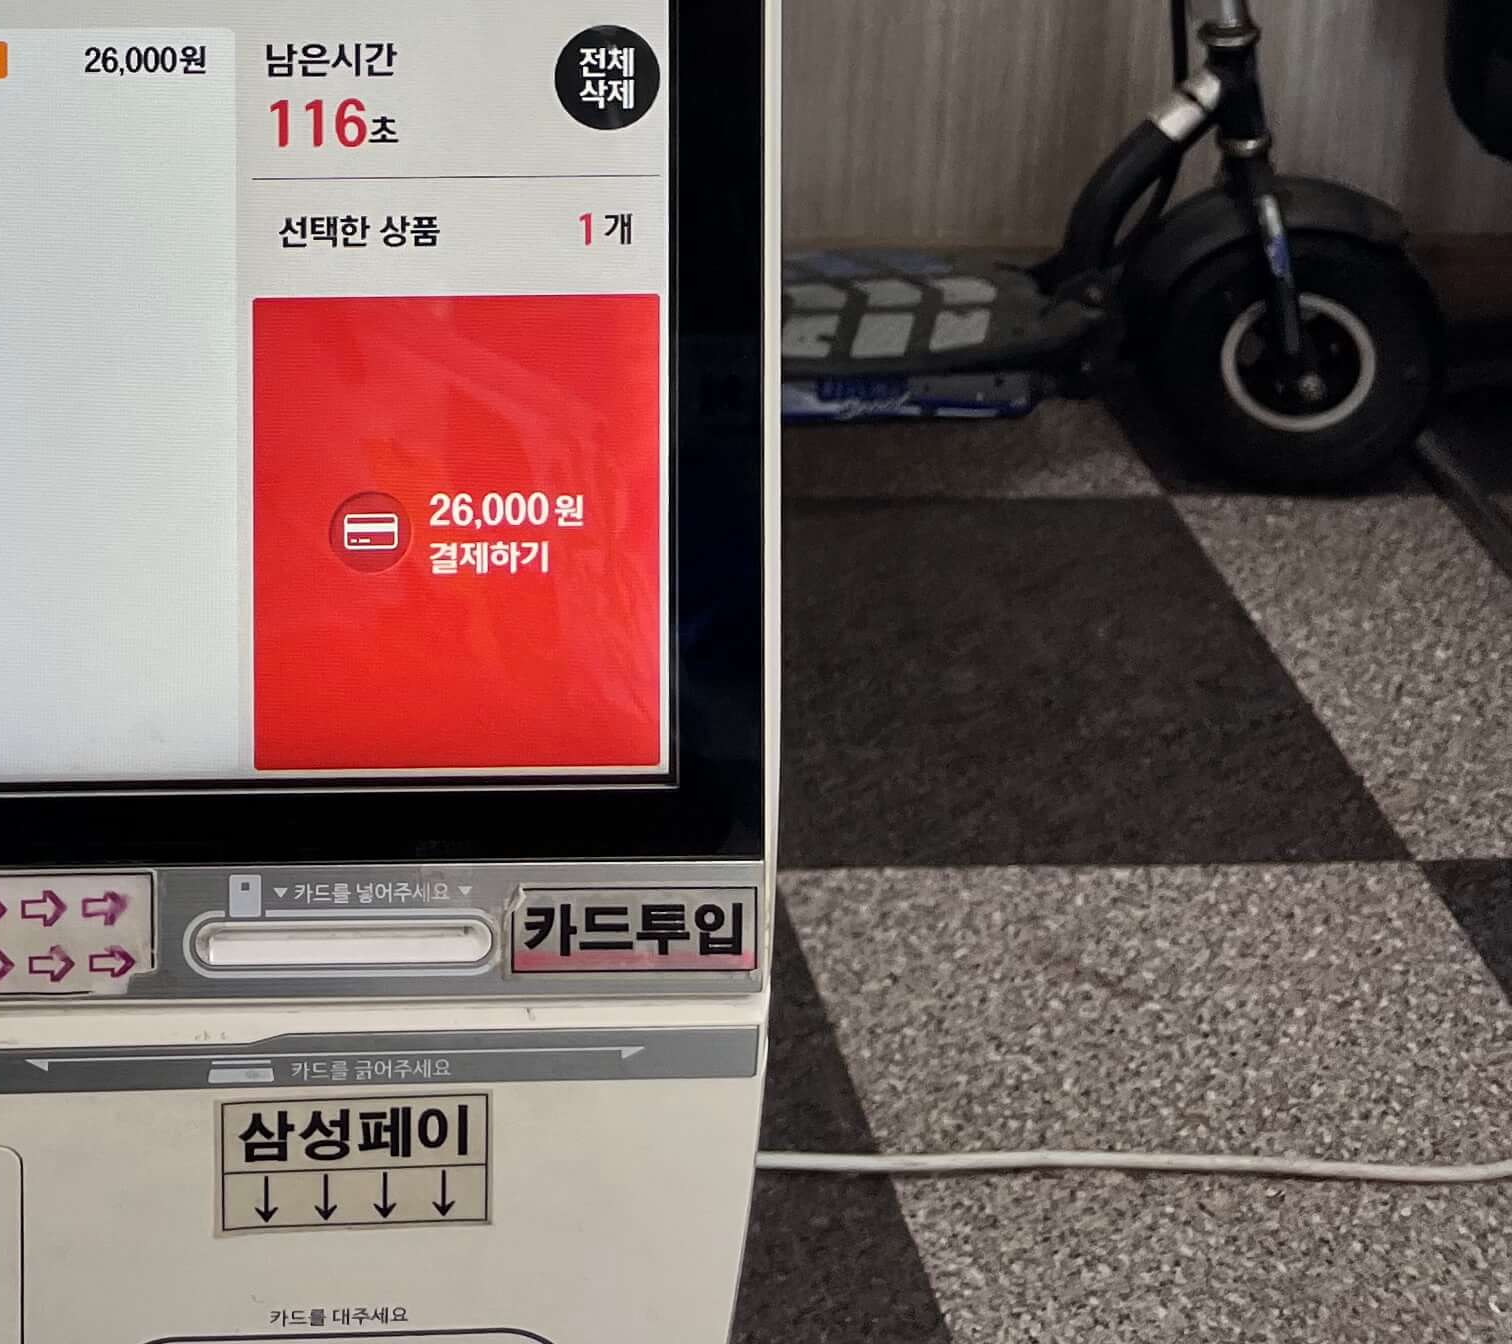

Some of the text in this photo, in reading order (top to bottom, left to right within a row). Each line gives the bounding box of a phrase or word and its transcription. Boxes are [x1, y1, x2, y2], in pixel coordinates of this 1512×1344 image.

[84, 45, 208, 77] 26,000원
[265, 43, 398, 79] 남은시간
[578, 47, 636, 79] 전체
[579, 79, 636, 111] 삭제
[269, 97, 400, 149] 116초
[277, 215, 441, 250] 선택한 상품
[428, 492, 585, 530] 26,000원
[428, 541, 551, 575] 결제하기
[293, 882, 451, 905] 카드를 넣어주세요
[523, 901, 744, 957] 카드투입
[290, 1057, 451, 1081] 카드를 긁어주세요
[239, 1104, 469, 1163] 삼성페이
[269, 1306, 409, 1327] 카드를 대주세요
